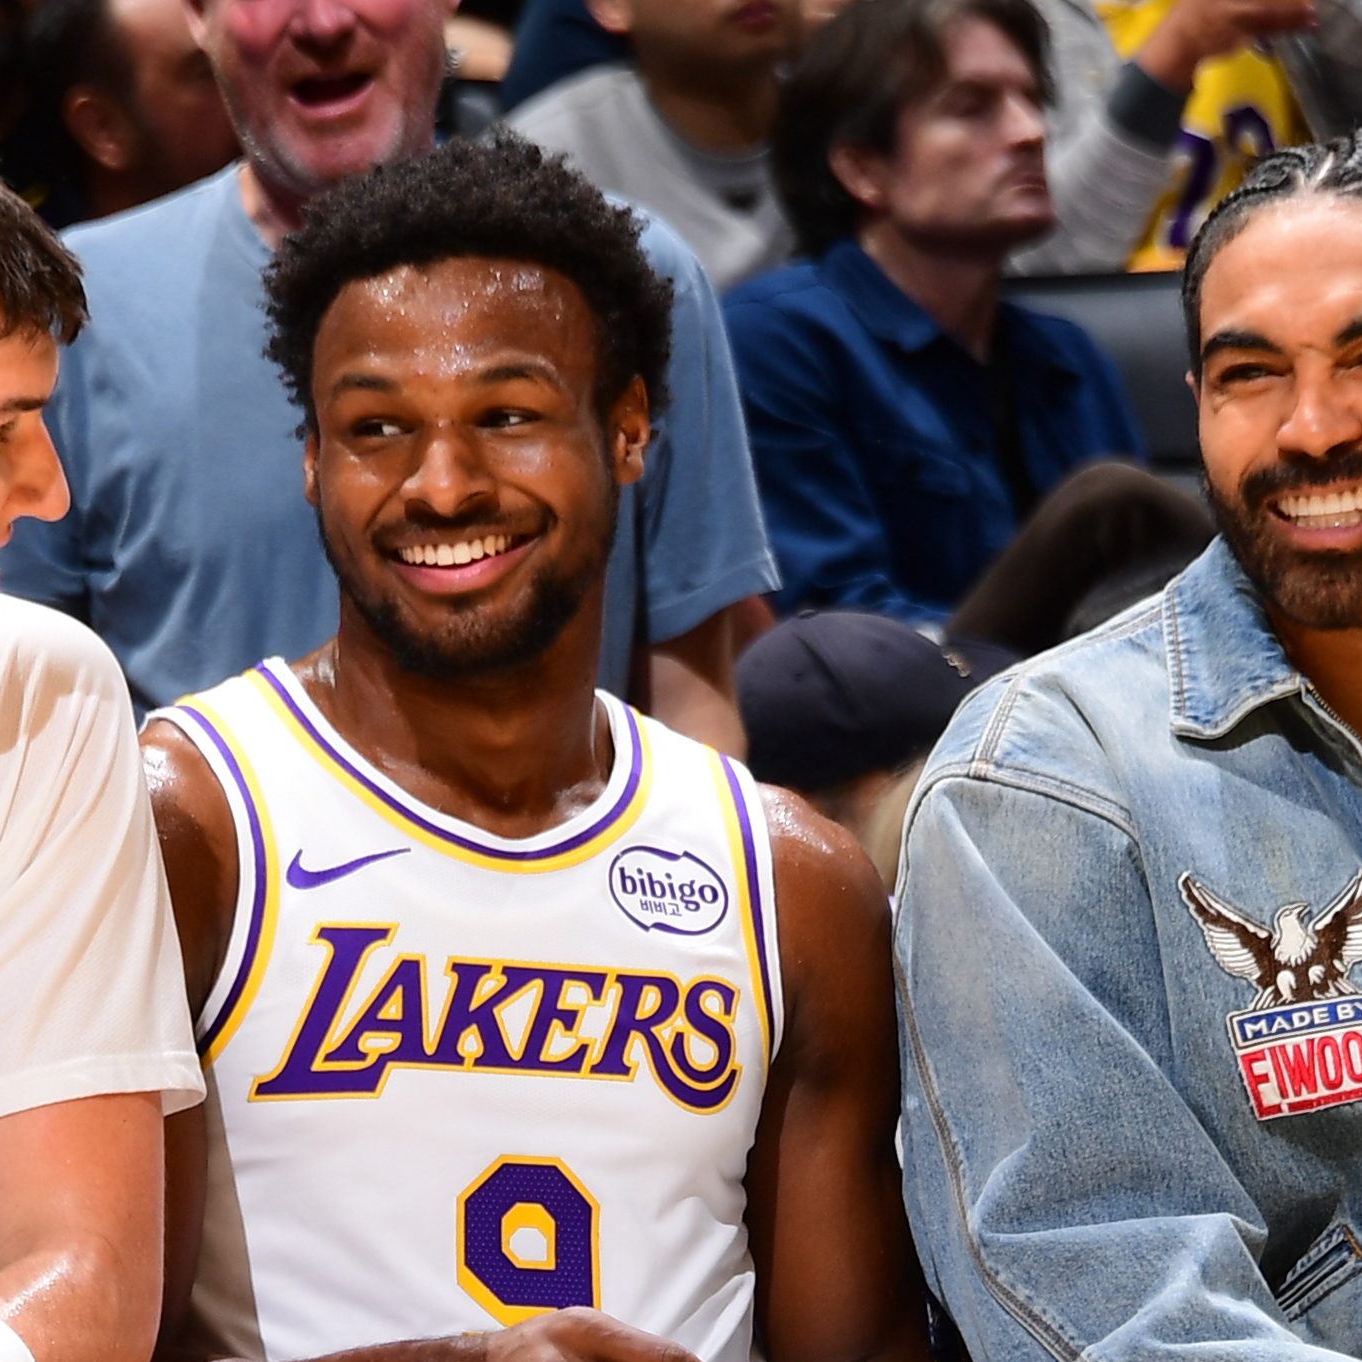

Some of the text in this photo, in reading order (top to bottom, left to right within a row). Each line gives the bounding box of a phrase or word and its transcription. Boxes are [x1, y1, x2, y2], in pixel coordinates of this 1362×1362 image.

[618, 866, 719, 912] bibigo
[639, 898, 682, 917] 비비고
[247, 921, 743, 1115] LAKERS
[1243, 1006, 1331, 1039] MADE
[456, 1154, 602, 1328] 9
